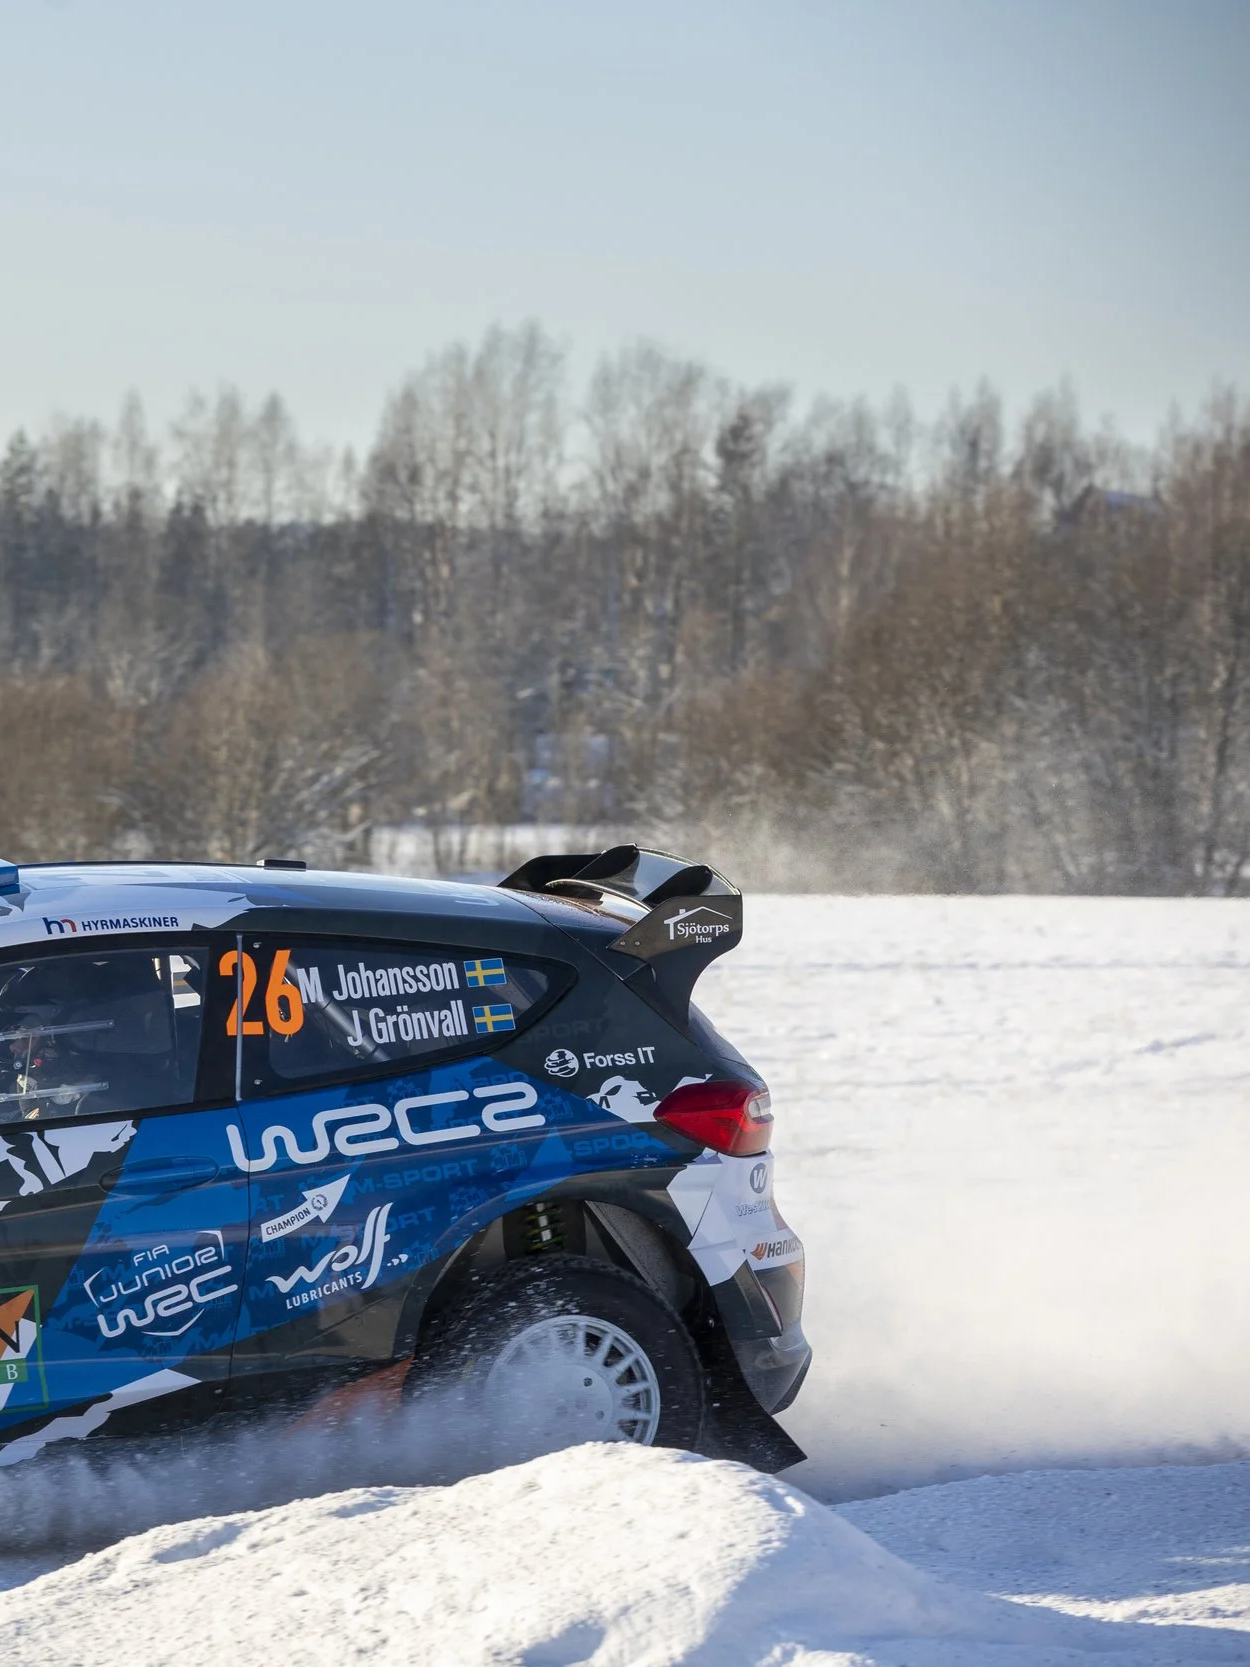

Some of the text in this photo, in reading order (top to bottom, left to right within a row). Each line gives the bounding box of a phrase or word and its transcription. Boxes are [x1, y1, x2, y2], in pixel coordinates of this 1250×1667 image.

[82, 916, 178, 931] HYRMASKINER
[677, 923, 729, 938] Sjötorps
[696, 935, 712, 943] Hus
[219, 949, 304, 1036] 26
[297, 961, 459, 1004] M Johansson
[347, 1000, 468, 1046] J Grönvall
[583, 1046, 655, 1069] Forss IT
[226, 1082, 546, 1172] WRC2
[266, 1207, 311, 1235] CHAMPION
[133, 1245, 169, 1266] FIA
[97, 1265, 238, 1338] WRC
[286, 1271, 363, 1309] LUBRICANTS
